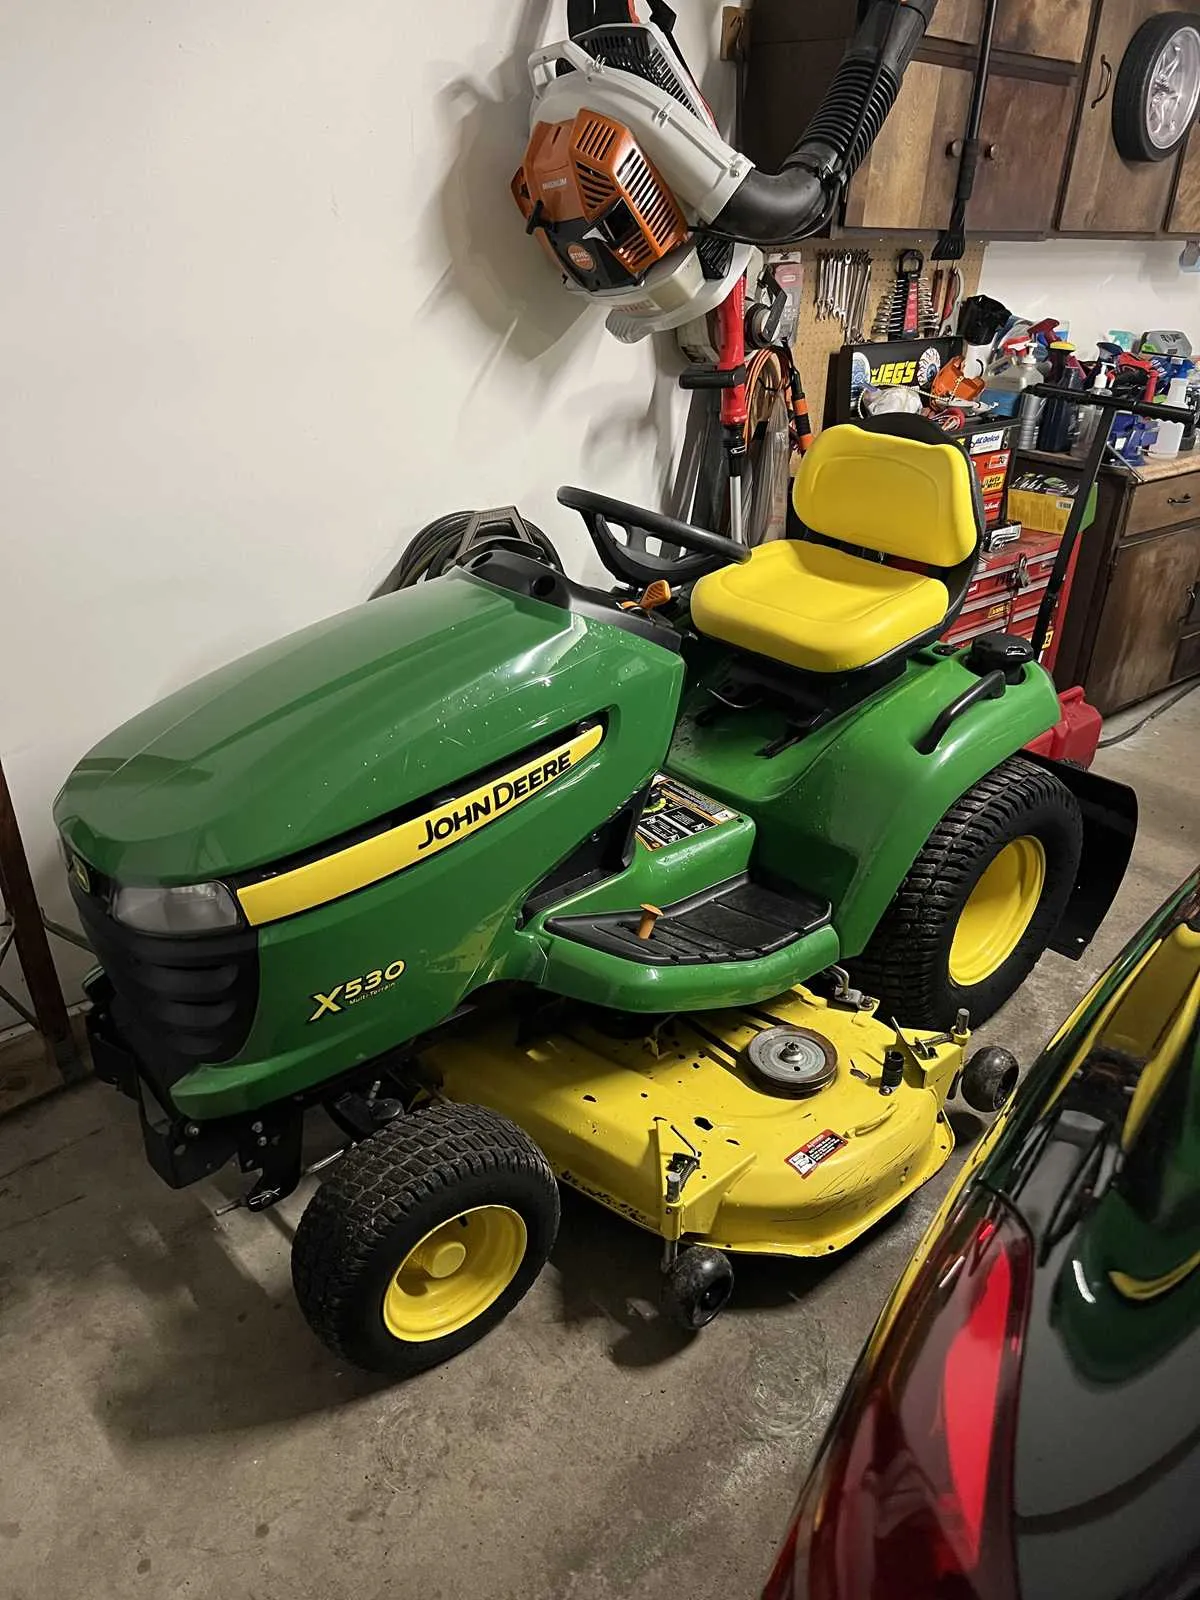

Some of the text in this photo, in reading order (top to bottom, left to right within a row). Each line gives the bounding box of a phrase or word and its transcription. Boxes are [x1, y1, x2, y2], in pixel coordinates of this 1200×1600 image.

[418, 750, 572, 850] JOHN DEERE
[308, 959, 406, 1022] X530
